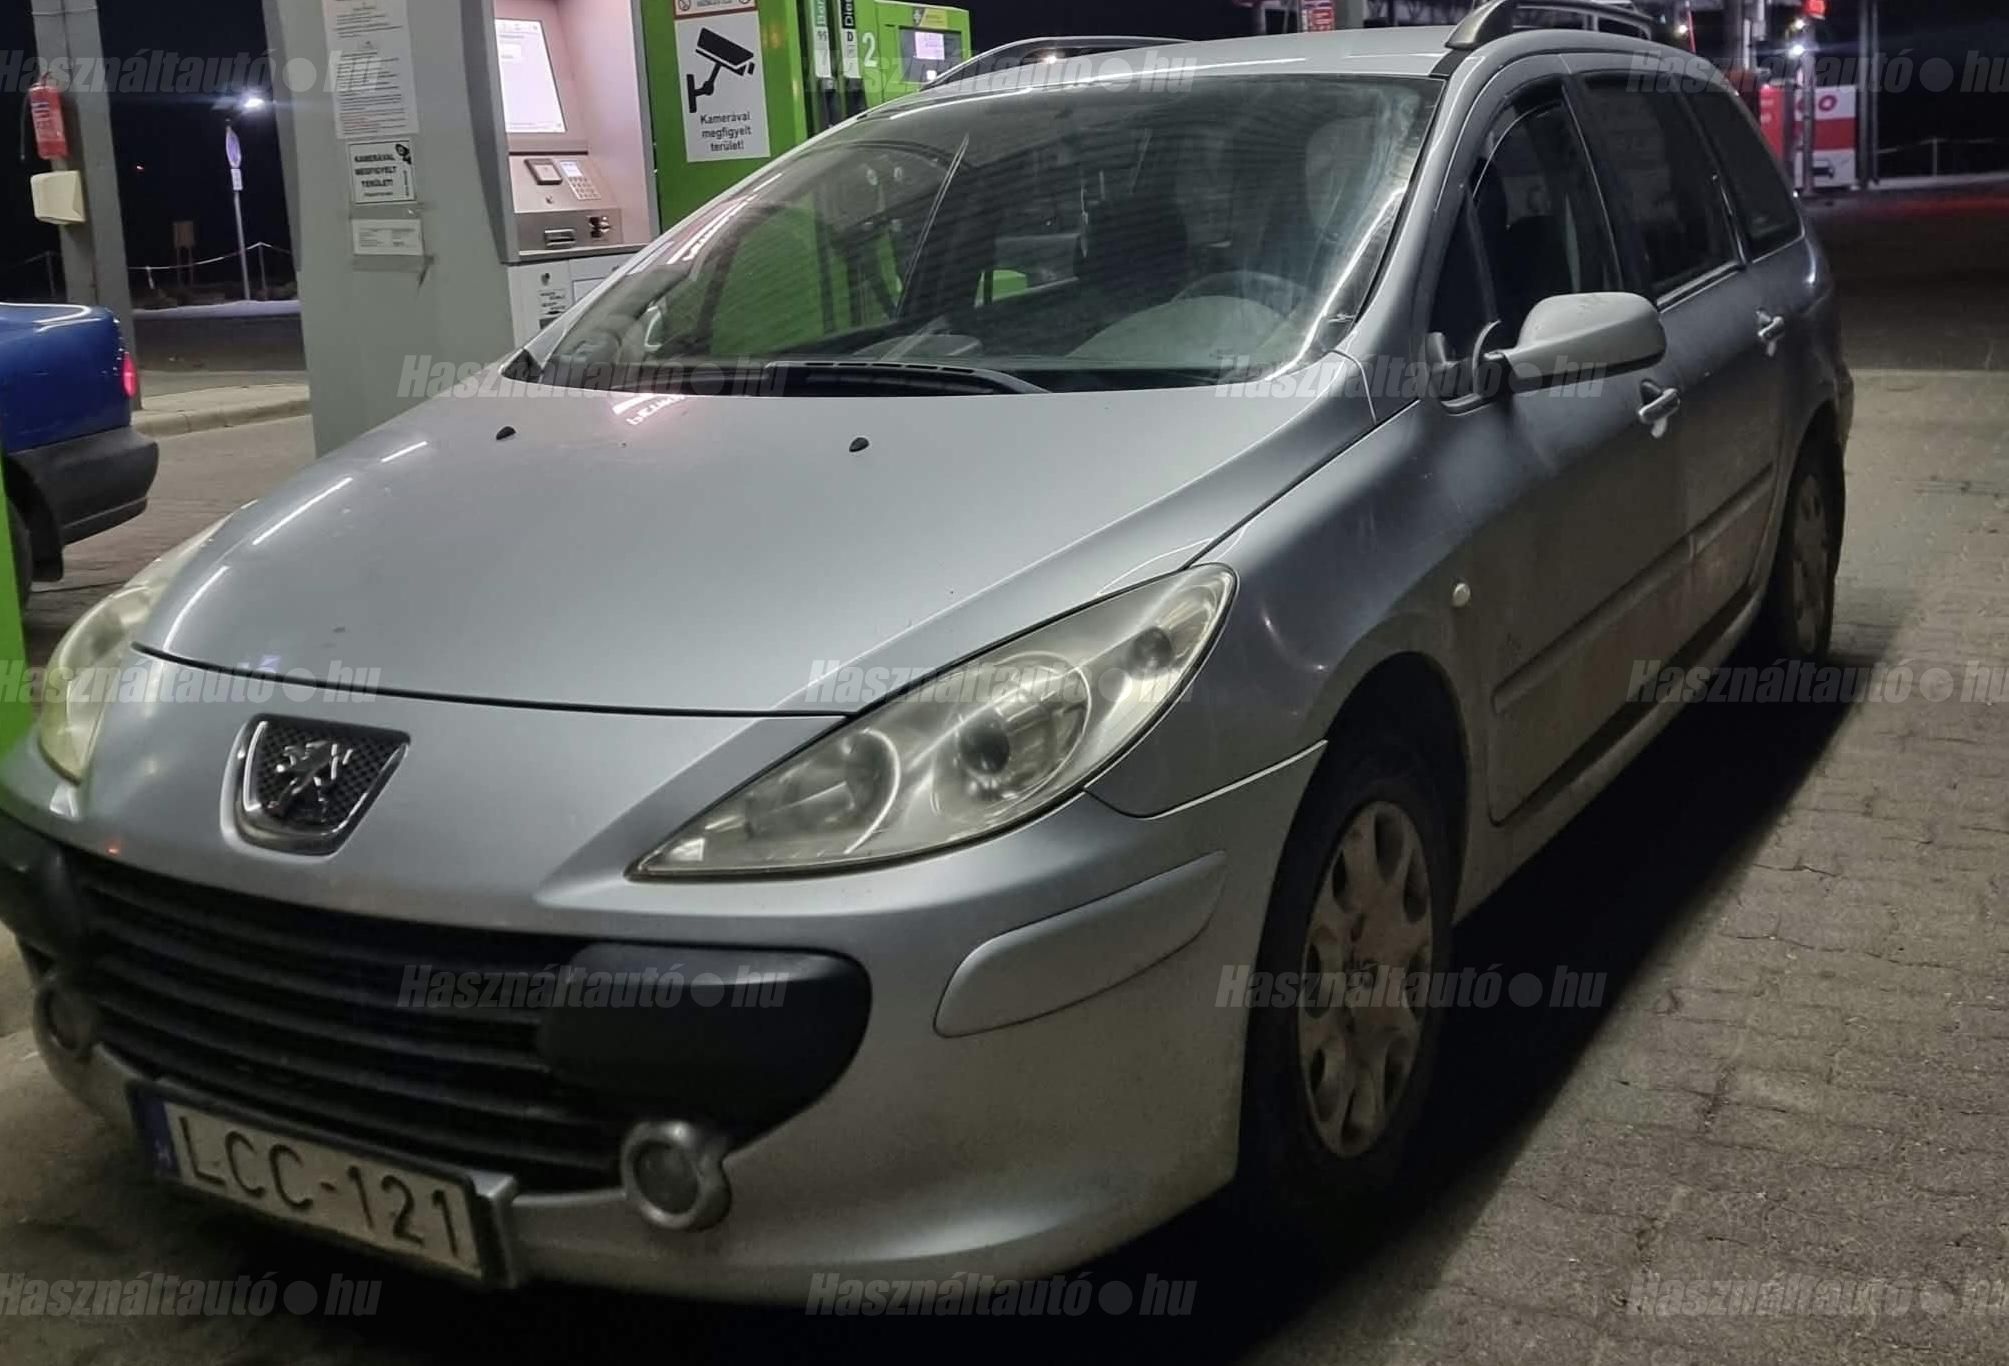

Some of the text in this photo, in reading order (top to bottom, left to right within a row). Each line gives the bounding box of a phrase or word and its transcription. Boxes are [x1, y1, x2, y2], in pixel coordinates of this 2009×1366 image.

[862, 32, 878, 67] 2
[700, 111, 751, 125] Kamerával
[701, 126, 752, 140] megfigyelt
[710, 139, 745, 151] terület!
[179, 1115, 460, 1257] LCC-121
